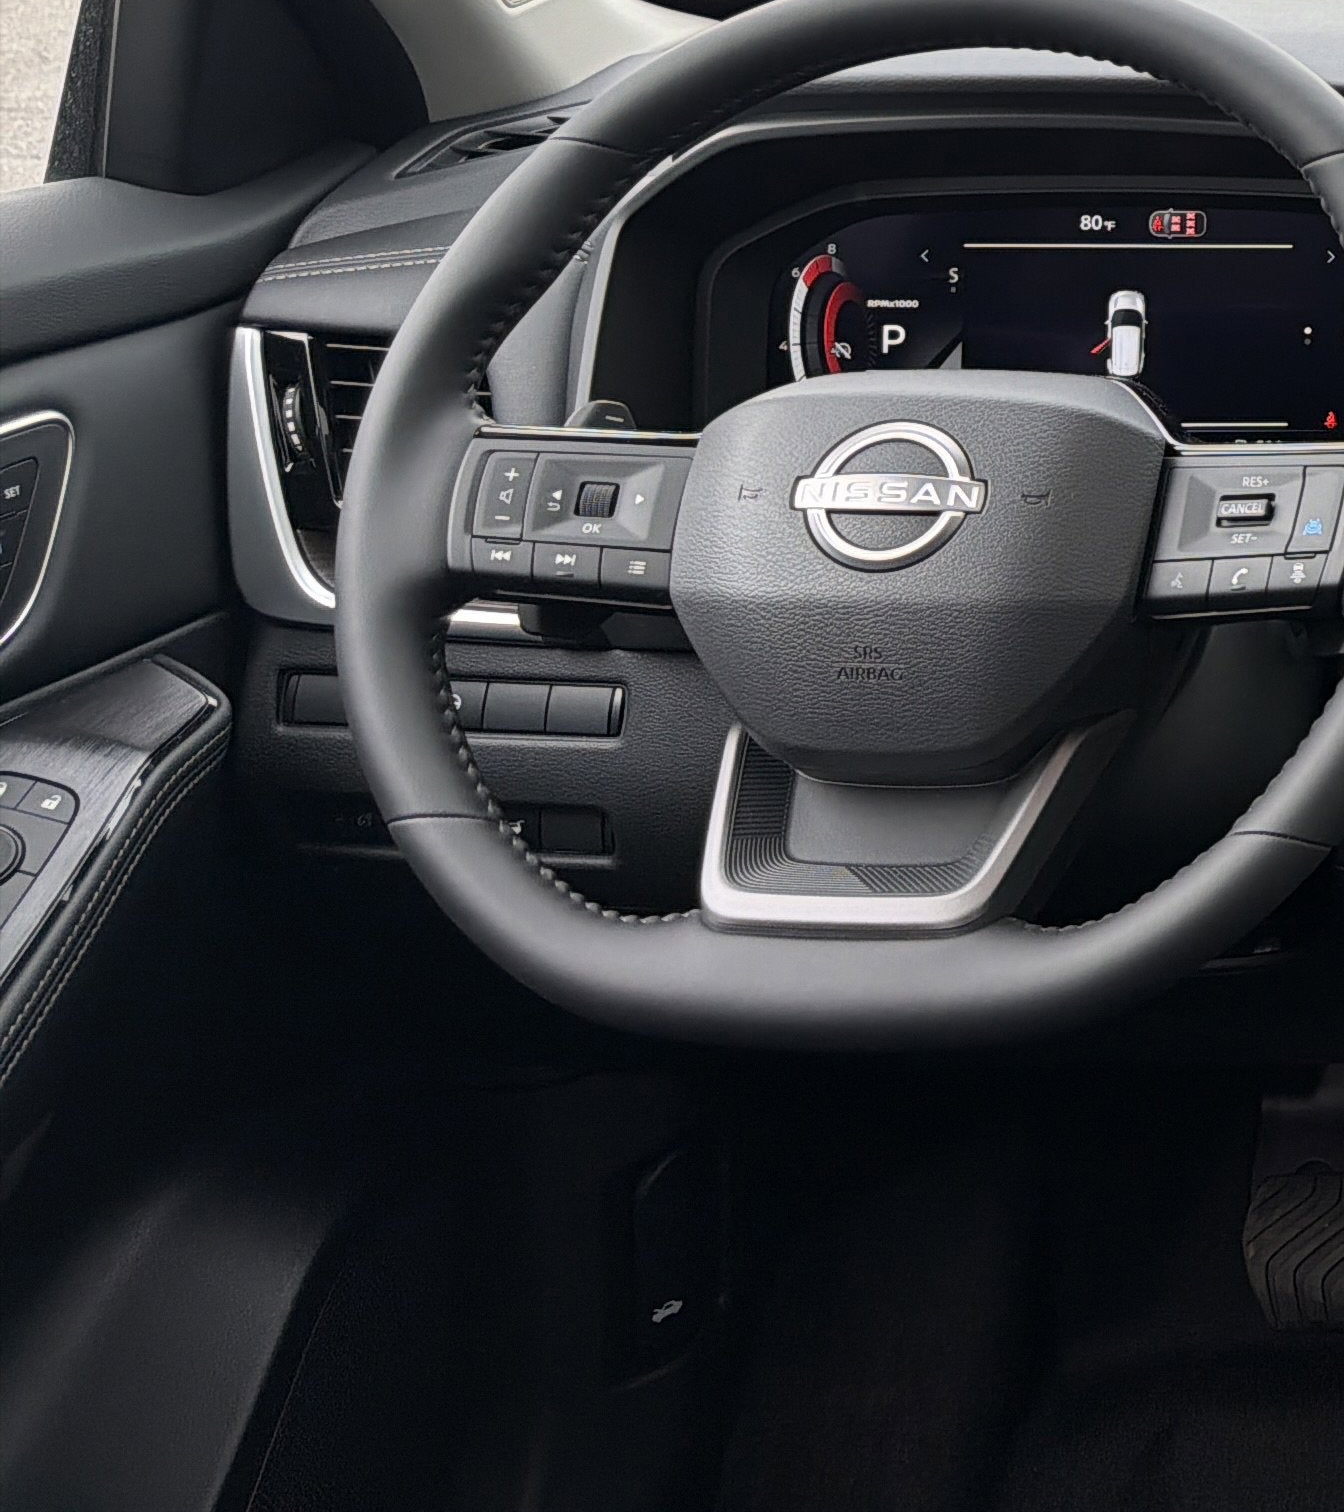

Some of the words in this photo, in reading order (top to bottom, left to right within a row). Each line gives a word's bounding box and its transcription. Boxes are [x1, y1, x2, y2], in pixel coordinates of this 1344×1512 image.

[826, 243, 838, 255] 8
[791, 266, 801, 278] 6
[948, 267, 960, 284] S
[778, 340, 789, 351] 4
[881, 324, 906, 354] P
[1242, 475, 1270, 488] RES+
[3, 484, 21, 499] SET
[799, 480, 981, 509] NISSAN
[1220, 502, 1265, 515] CANCEL
[581, 522, 603, 535] OK
[853, 644, 883, 660] SRS
[836, 666, 904, 682] AIRBAG
